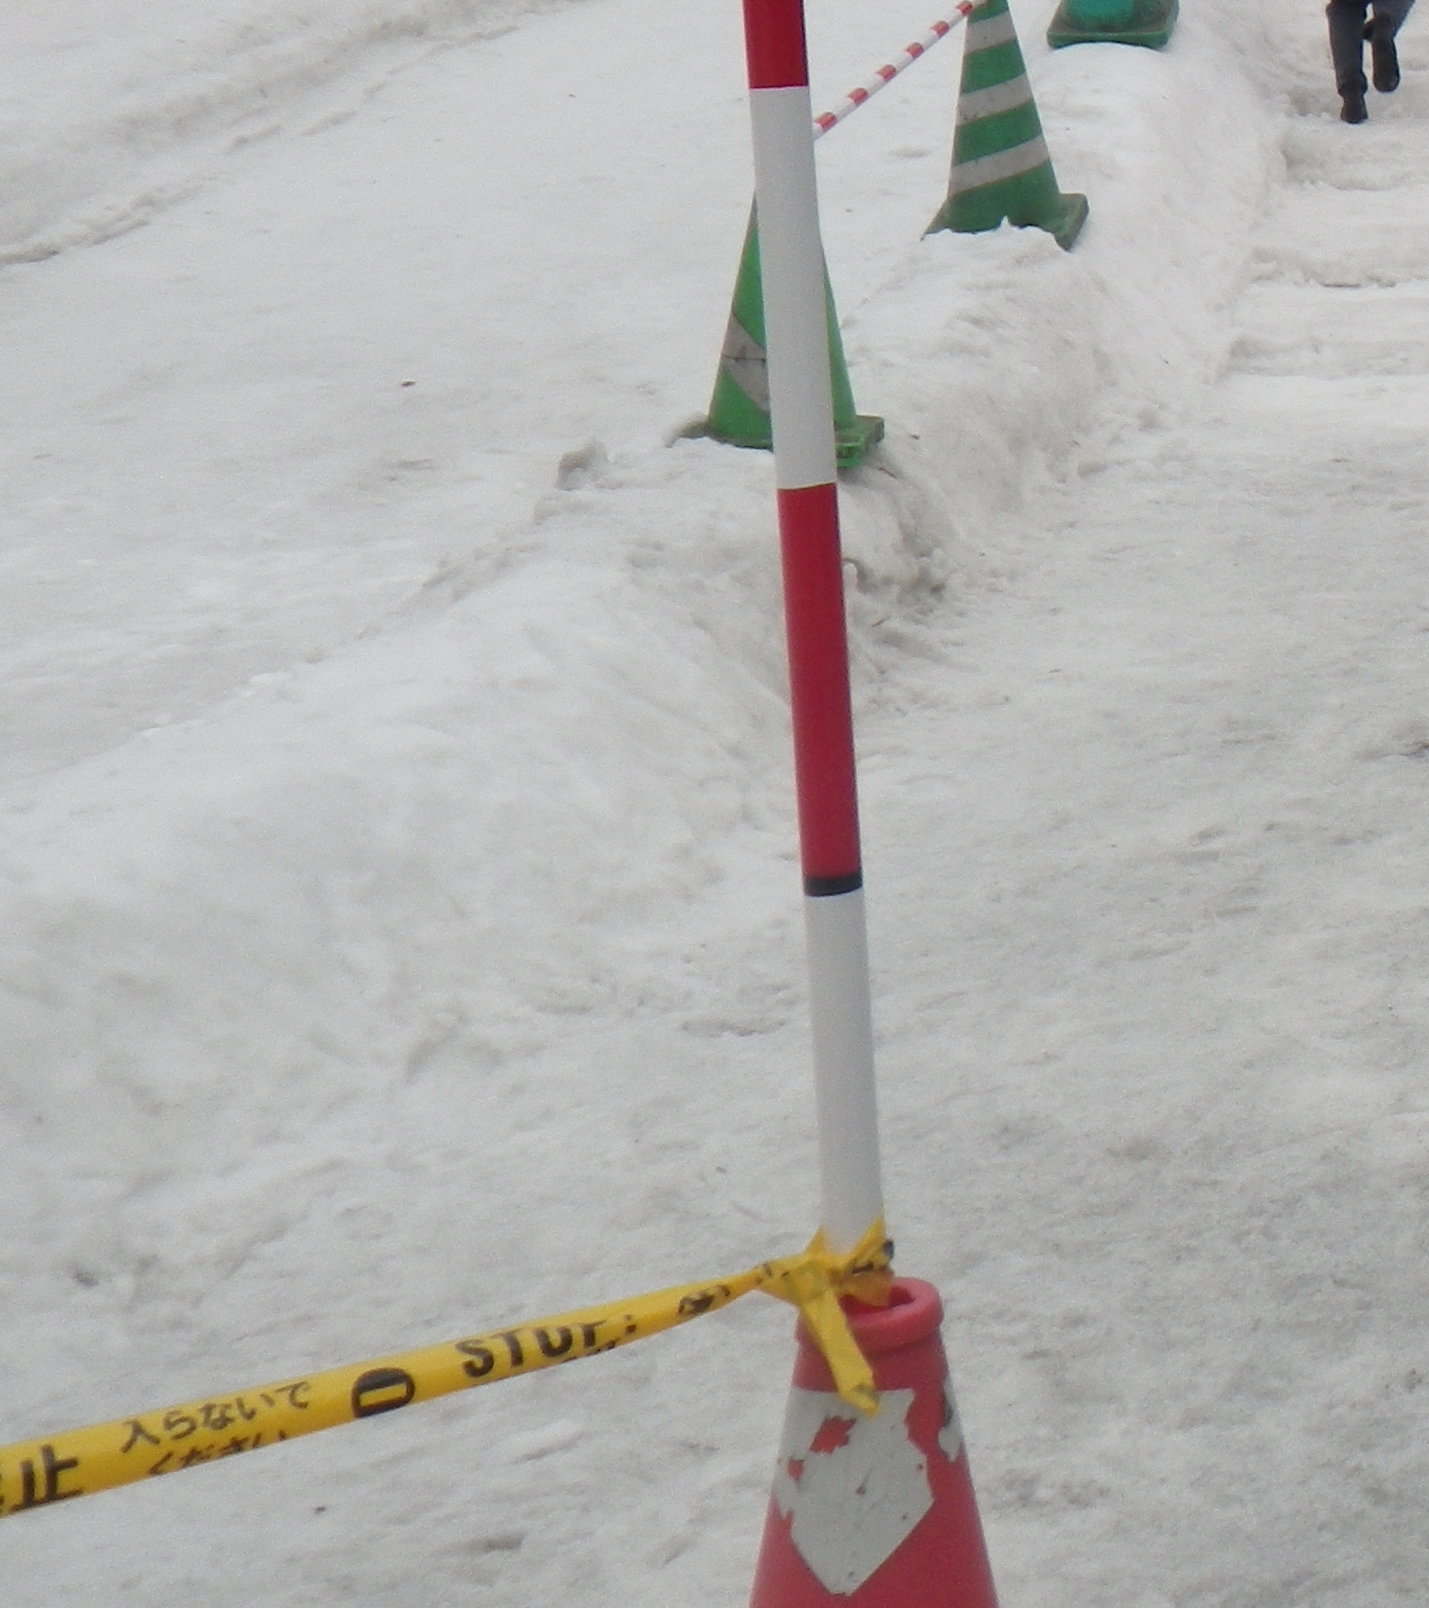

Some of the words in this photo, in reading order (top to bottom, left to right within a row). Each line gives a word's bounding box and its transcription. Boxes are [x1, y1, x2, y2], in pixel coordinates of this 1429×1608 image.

[120, 1381, 311, 1454] 入らないで
[0, 1444, 84, 1514] 止
